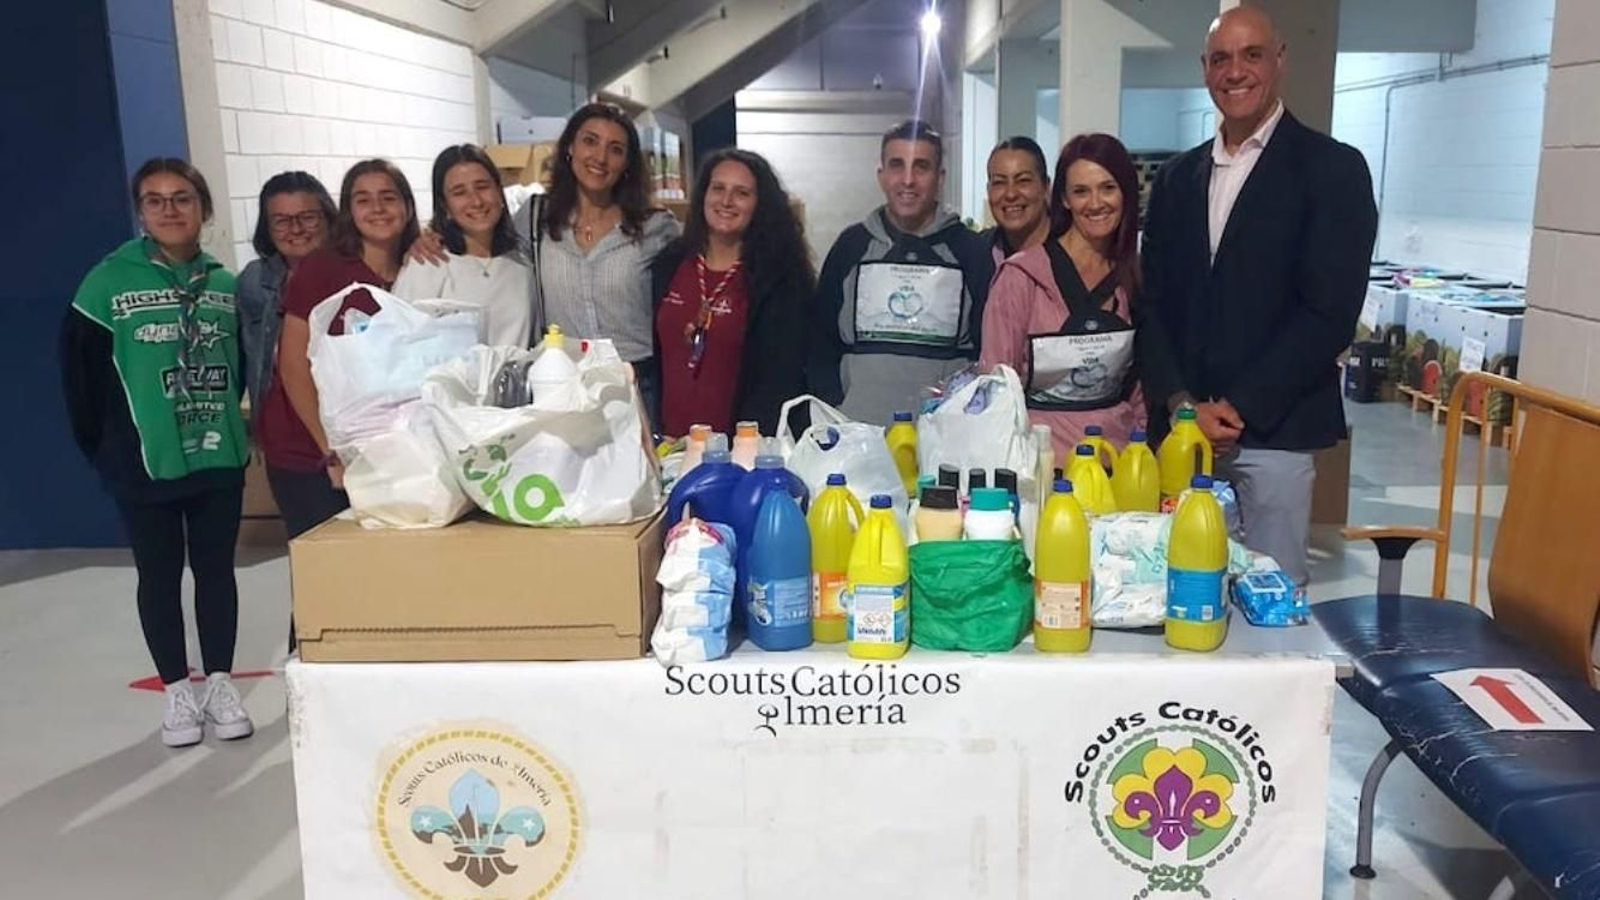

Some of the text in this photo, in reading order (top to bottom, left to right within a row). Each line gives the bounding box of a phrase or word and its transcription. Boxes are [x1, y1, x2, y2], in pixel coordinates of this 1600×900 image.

[1068, 334, 1114, 346] PROGRAMA
[202, 430, 222, 451] 2
[664, 663, 962, 696] Scouts Católicos
[1064, 701, 1276, 804] Scouts Católicos
[398, 772, 426, 807] Scouts
[424, 751, 488, 775] Católicos
[490, 754, 508, 769] de
